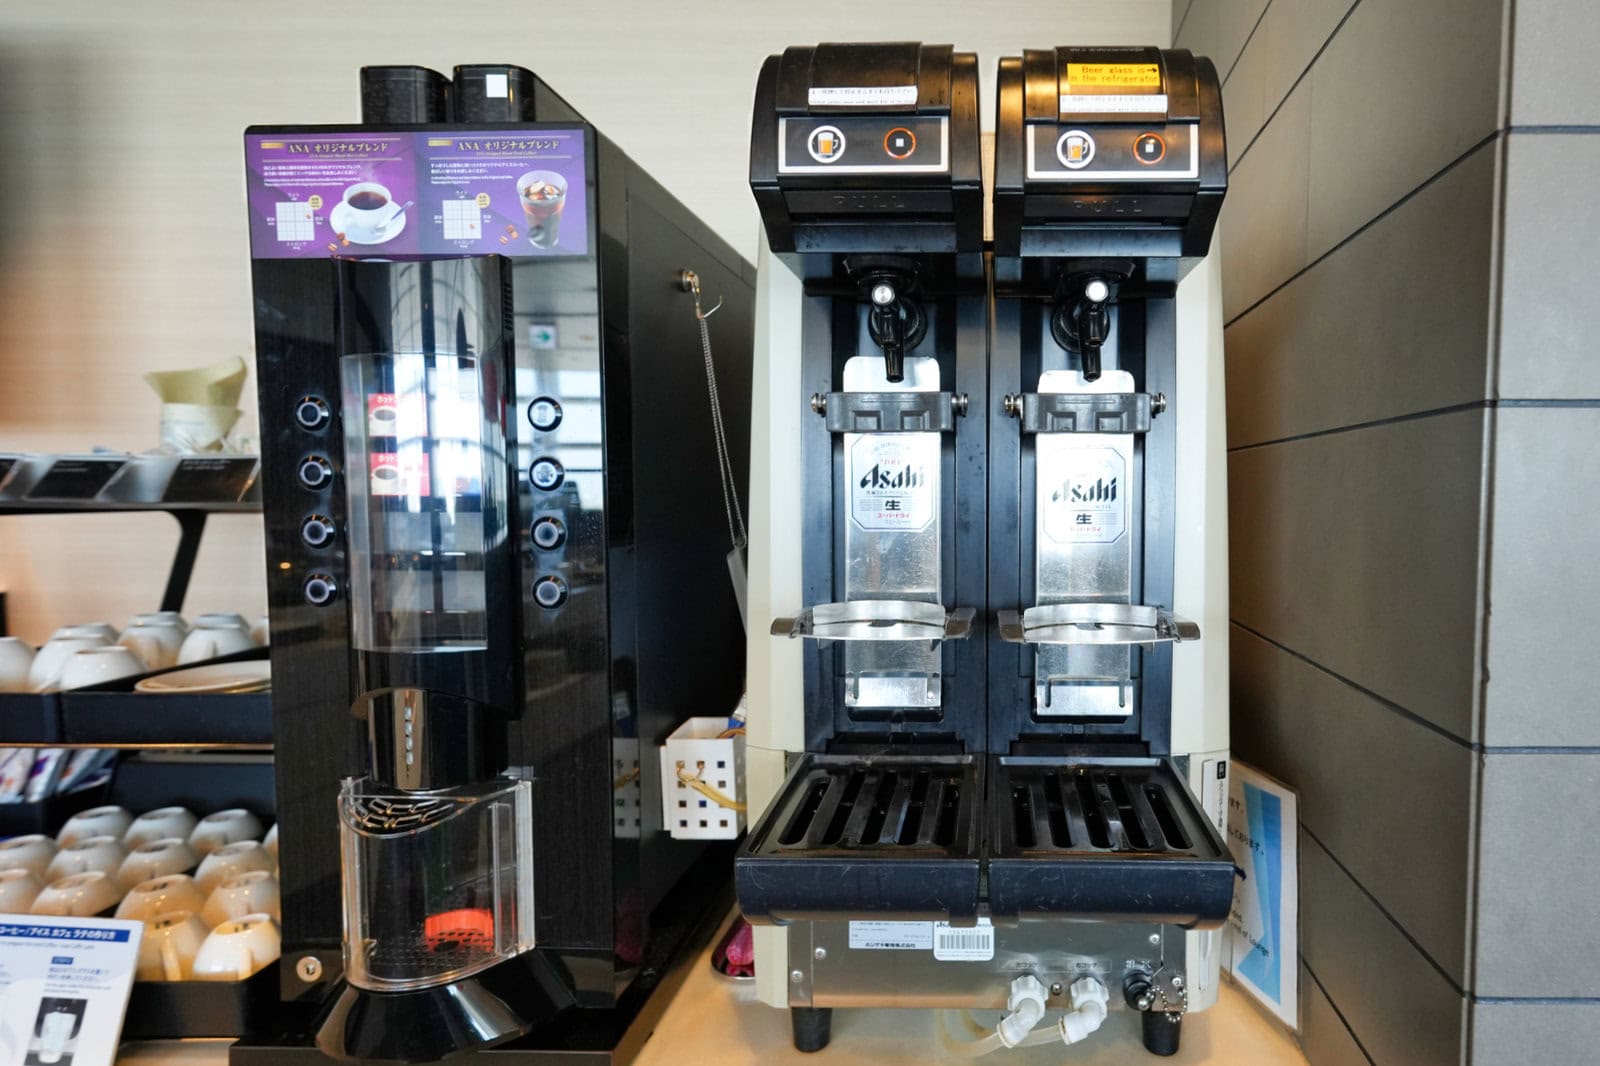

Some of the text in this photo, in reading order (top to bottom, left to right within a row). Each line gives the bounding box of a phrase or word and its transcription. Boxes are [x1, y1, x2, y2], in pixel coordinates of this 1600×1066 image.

[1082, 66, 1102, 74] Beer
[1109, 66, 1134, 75] glass
[1101, 74, 1158, 82] refrigerator
[288, 144, 309, 153] ANA
[314, 143, 389, 153] オリジナルブレンド
[457, 141, 480, 151] ANA
[484, 140, 560, 150] オリジナルブレンド
[860, 463, 925, 489] Asahi
[1051, 476, 1117, 503] Asahi
[885, 500, 902, 511] 生
[1075, 513, 1092, 525] 生
